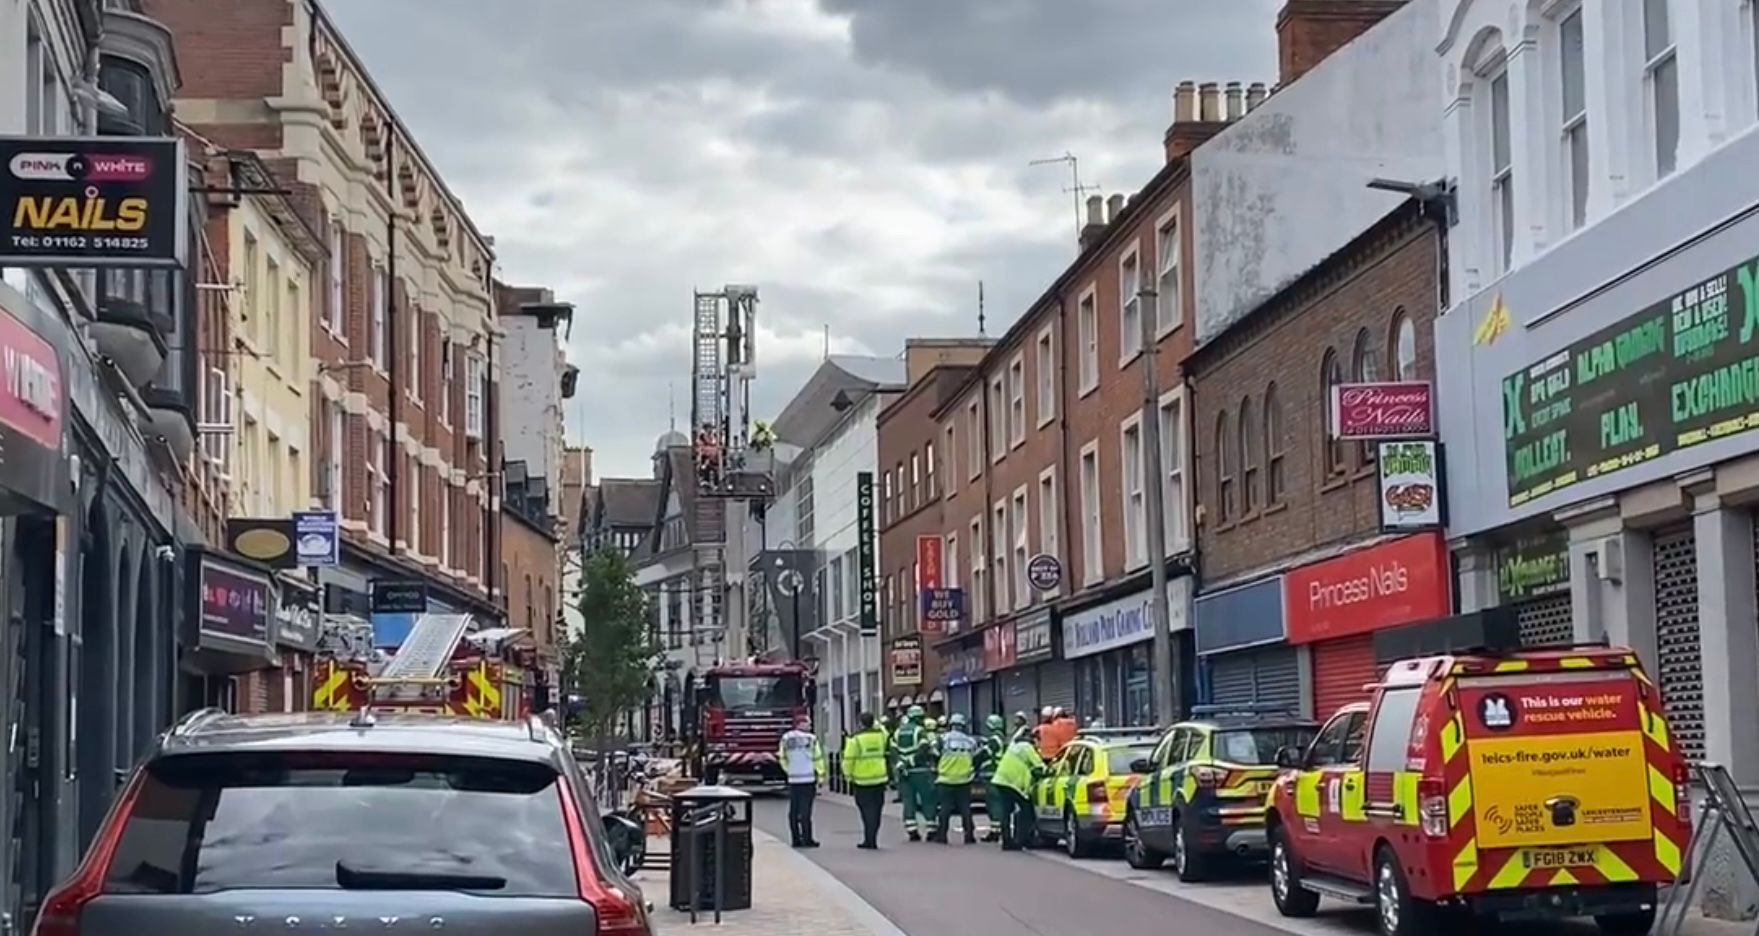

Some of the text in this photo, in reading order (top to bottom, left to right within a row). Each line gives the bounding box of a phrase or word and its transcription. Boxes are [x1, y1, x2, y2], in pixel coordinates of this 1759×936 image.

[20, 160, 61, 171] PINK
[94, 158, 146, 172] WHITE
[13, 185, 148, 231] NAILS
[12, 235, 149, 249] Tel: 01162 514825
[1342, 389, 1428, 407] Princess
[1347, 405, 1427, 426] Nails
[860, 484, 873, 615] COFFEE SHOP
[1309, 561, 1408, 612] Princess Nails
[928, 611, 959, 619] GOLD
[1521, 695, 1622, 708] This is our water
[1524, 709, 1617, 723] rescue vehicle.
[1481, 747, 1631, 764] leics-fire.gov.uk/water
[1534, 850, 1596, 866] FG18 ZWX
